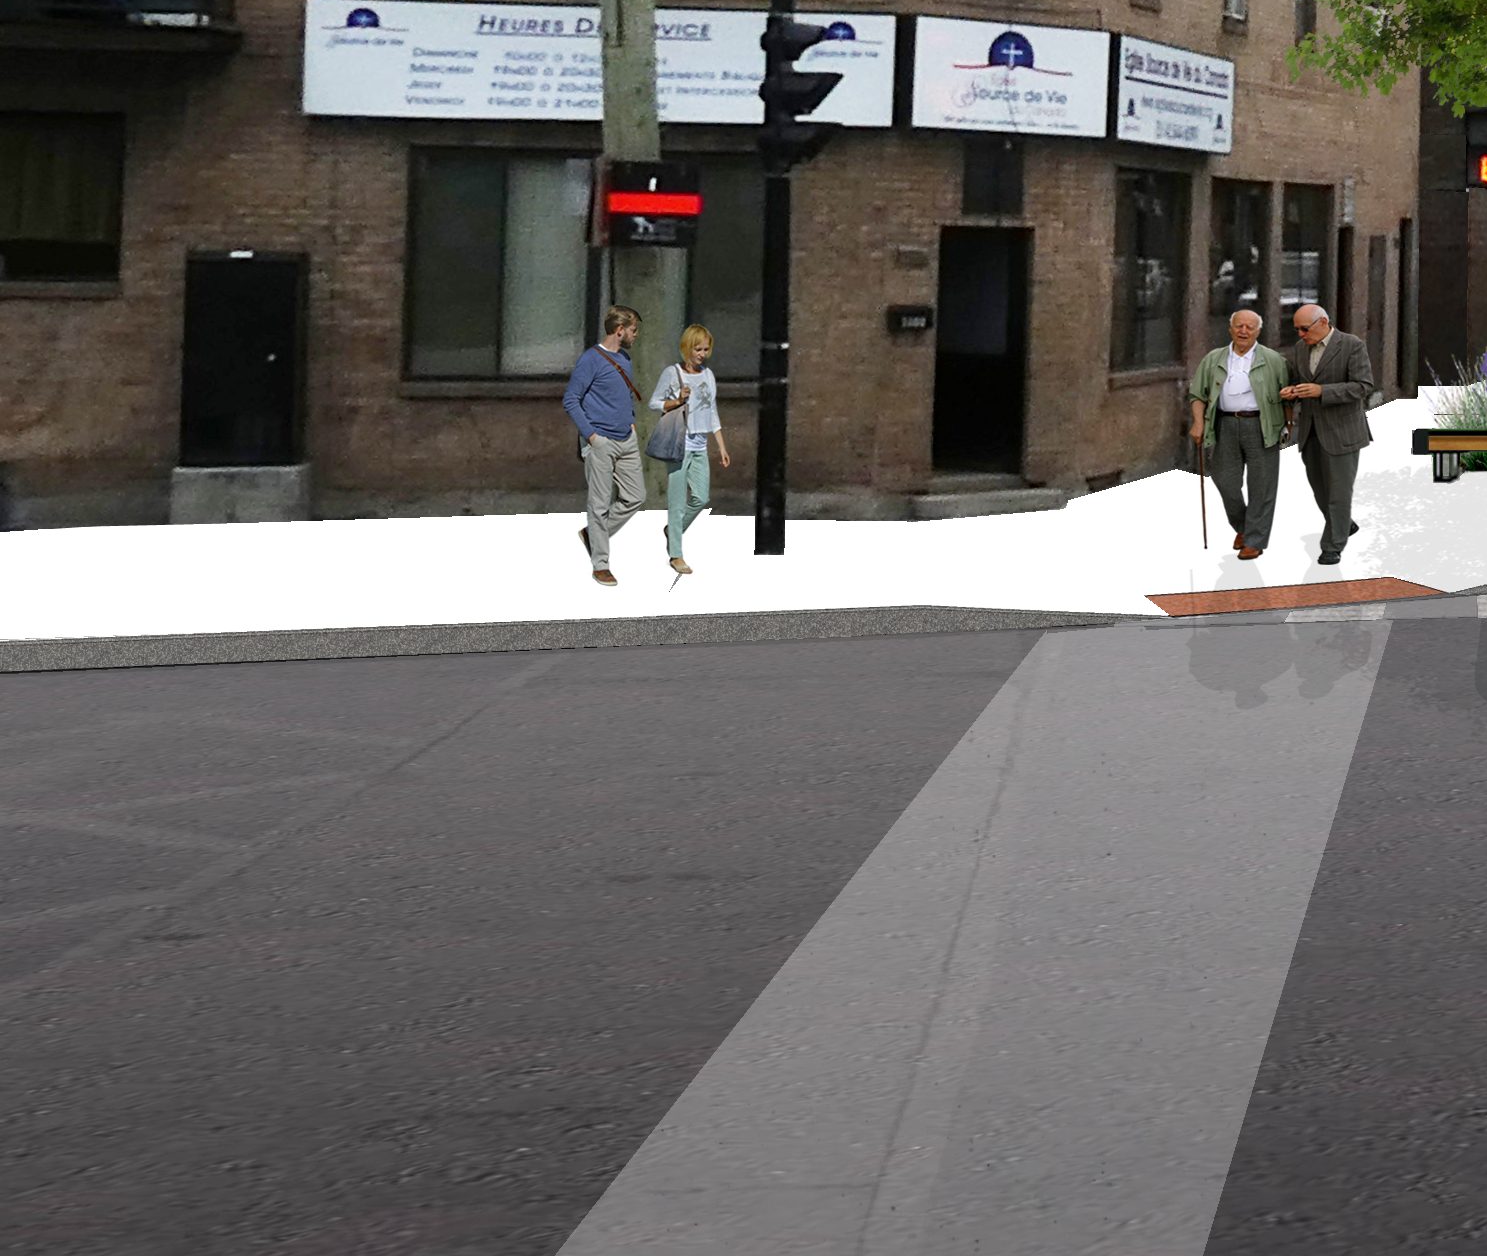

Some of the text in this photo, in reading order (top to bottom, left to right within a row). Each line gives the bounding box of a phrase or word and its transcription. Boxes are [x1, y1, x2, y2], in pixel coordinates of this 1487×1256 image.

[479, 15, 564, 34] HEURES
[655, 23, 711, 39] VICE
[1024, 89, 1042, 103] de
[1046, 90, 1068, 105] Vie
